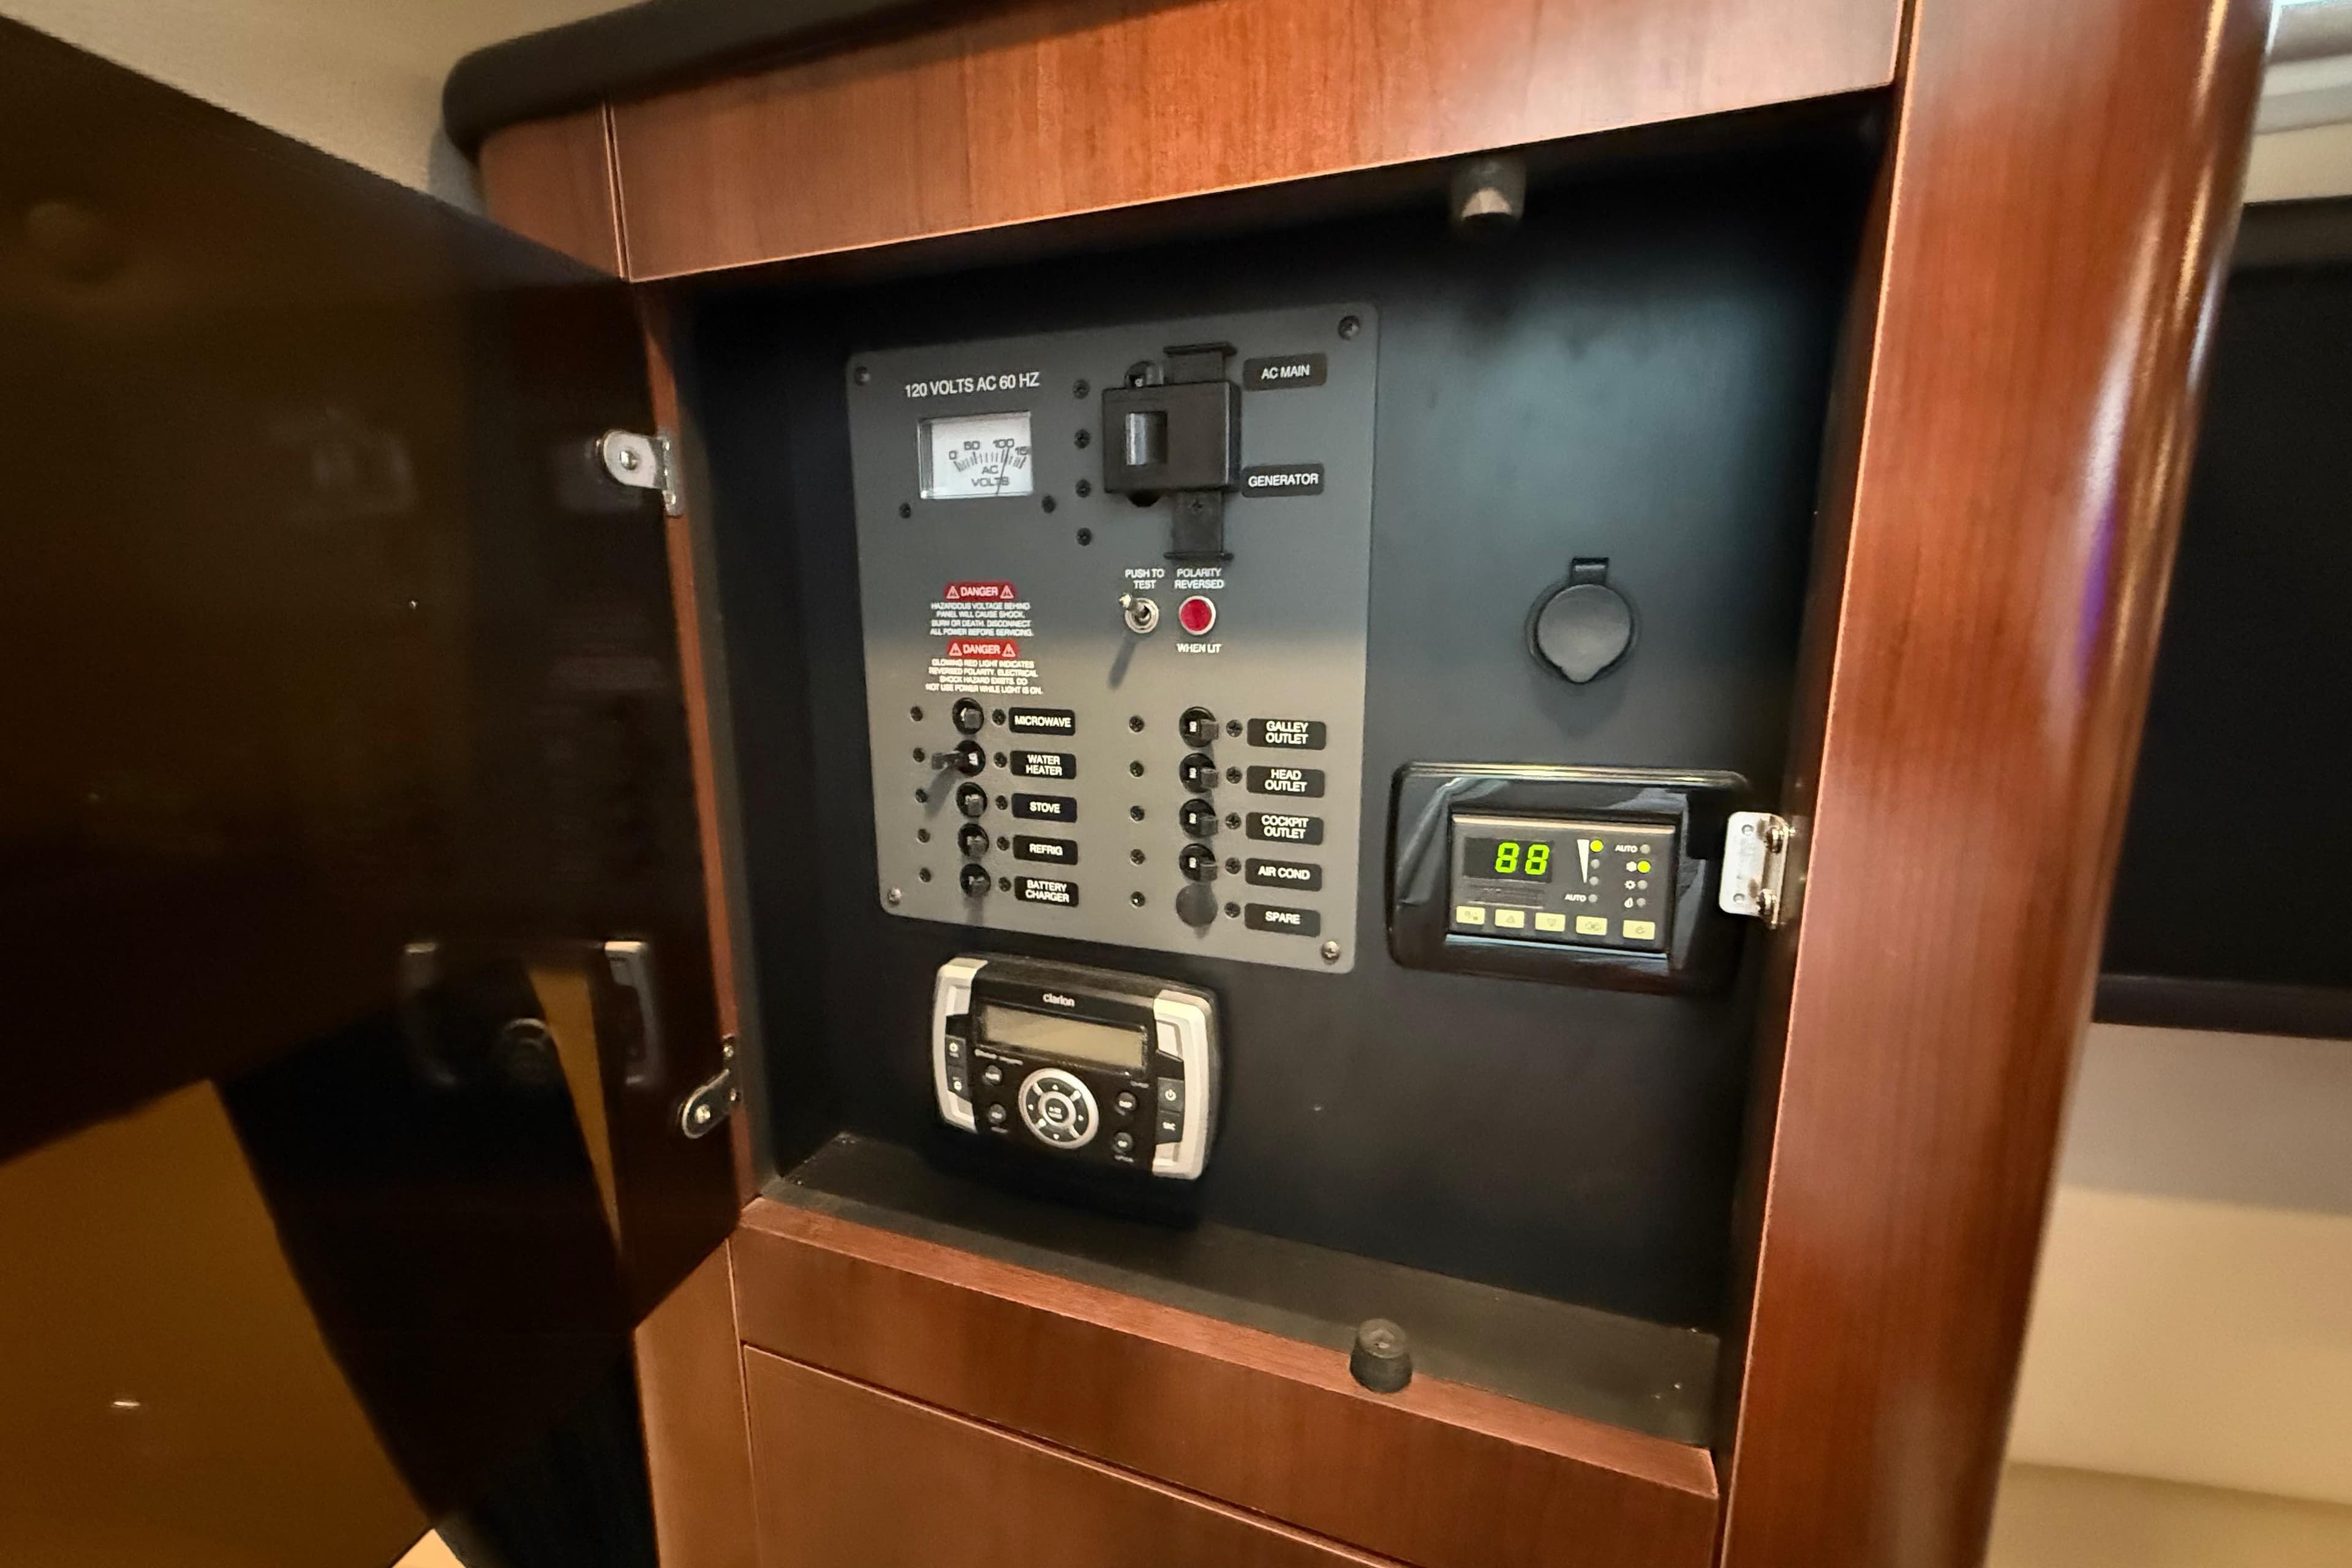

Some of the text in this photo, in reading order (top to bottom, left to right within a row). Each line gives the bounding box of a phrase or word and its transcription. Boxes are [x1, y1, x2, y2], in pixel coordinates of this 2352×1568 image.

[1261, 364, 1310, 380] AC MAIN
[905, 372, 1040, 398] 120 VOLTS AC 60 HZ
[963, 440, 980, 451] 50
[993, 438, 1014, 448] 100
[949, 450, 957, 460] 0
[981, 466, 998, 475] AC
[971, 477, 1009, 487] VOLTS
[1248, 473, 1319, 488] GENERATOR
[1125, 568, 1165, 578] PUSH TO
[1176, 568, 1222, 578] POLARITY
[1133, 579, 1156, 589] TEST
[1174, 579, 1224, 589] REVERSED
[960, 586, 998, 597] DANGER
[963, 644, 1001, 654] DANGER
[1176, 643, 1222, 654] WHEN LIT
[999, 660, 1035, 669] INDICATES
[1014, 715, 1071, 728] MICROWAVE
[1266, 721, 1308, 733] GALLEY
[1265, 733, 1308, 744] OUTLET
[1027, 754, 1060, 765] WATER
[1026, 766, 1062, 775] HEATER
[1271, 769, 1302, 780] HEAD
[1265, 780, 1307, 792] OUTLET
[1030, 802, 1060, 813] STOVE
[1261, 815, 1309, 827] COCKPIT
[1264, 827, 1306, 839] OUTLET
[1030, 843, 1063, 856] REFRIG
[1495, 842, 1550, 875] 88
[1258, 866, 1310, 880] AIR COND
[1027, 880, 1067, 892] BATTERY
[1025, 890, 1069, 903] CHARGER
[1564, 894, 1586, 902] AUTO
[1265, 911, 1300, 924] SPARE
